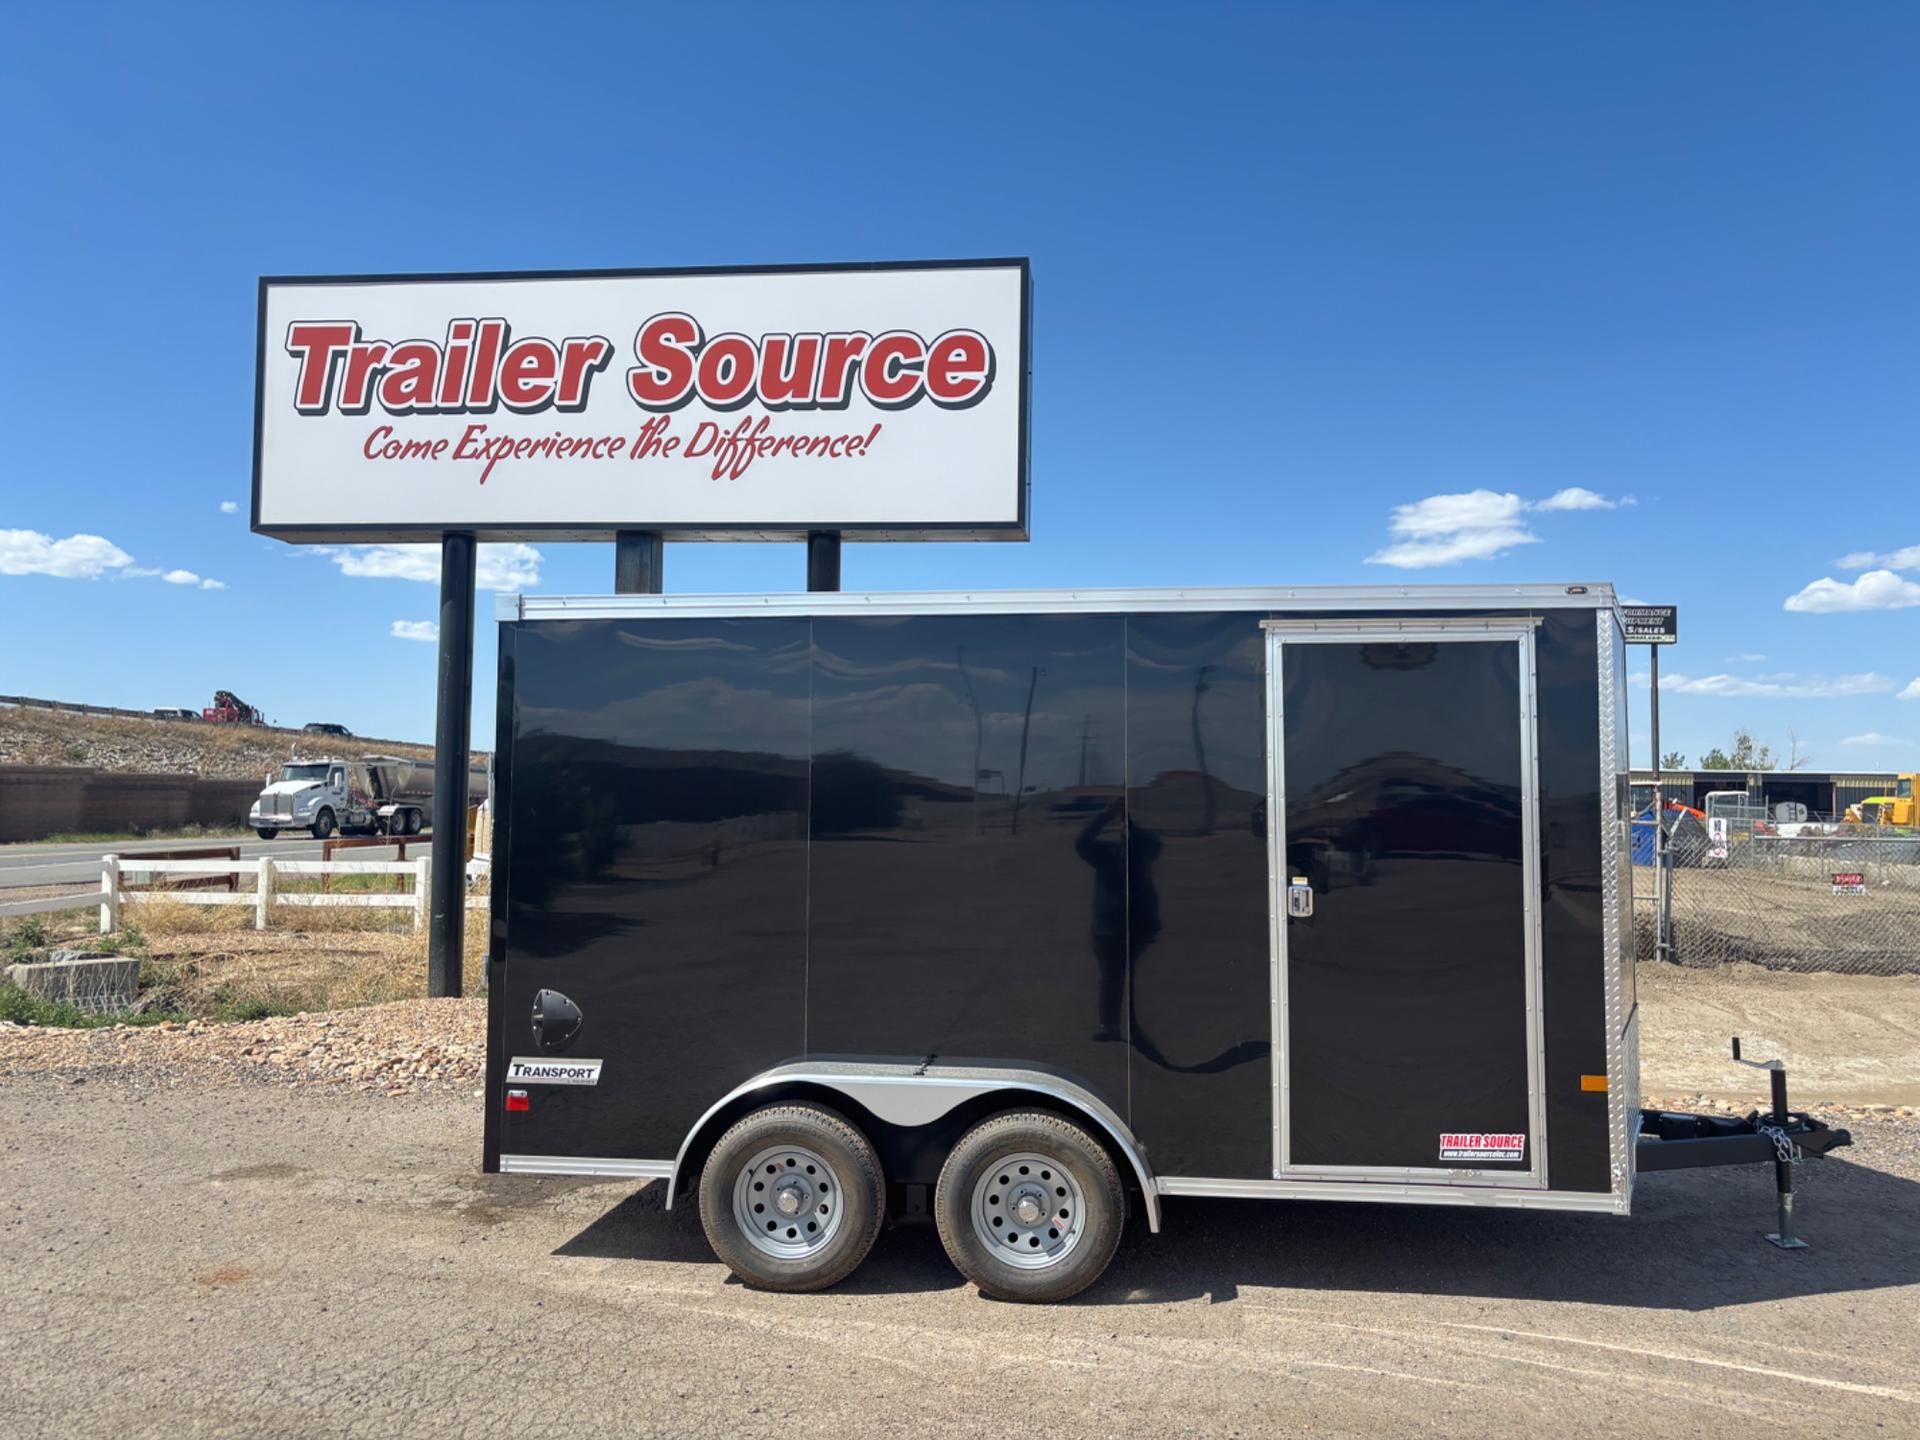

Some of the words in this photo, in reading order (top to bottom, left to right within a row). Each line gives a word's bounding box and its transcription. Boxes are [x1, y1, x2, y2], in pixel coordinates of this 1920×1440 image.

[286, 318, 614, 415] Trailer
[627, 312, 997, 413] Source
[363, 425, 449, 460] Come
[452, 424, 625, 485] Experience
[630, 414, 681, 460] the
[683, 415, 882, 481] Difference!
[513, 1064, 594, 1078] TRANSPORT
[1441, 1135, 1481, 1148] TRAILER
[1483, 1135, 1523, 1149] SOURCE
